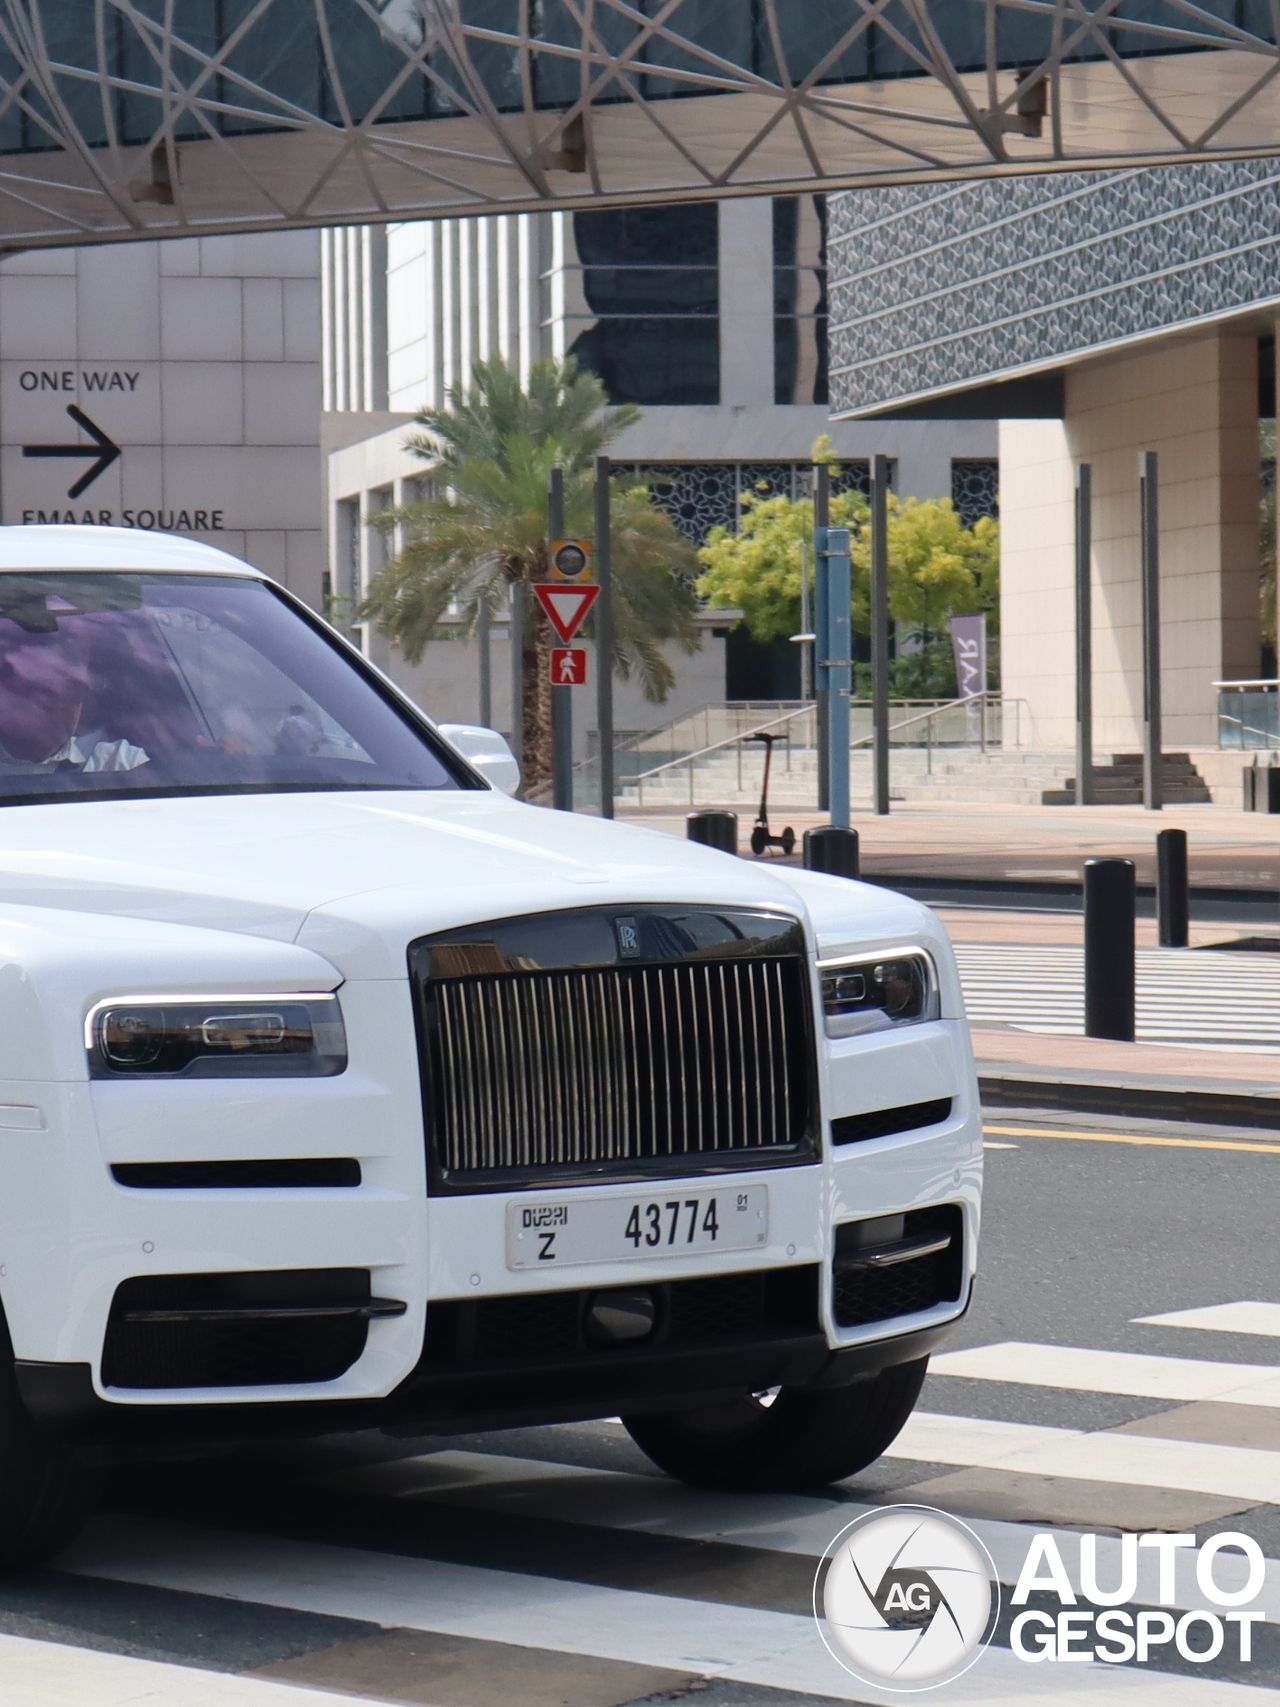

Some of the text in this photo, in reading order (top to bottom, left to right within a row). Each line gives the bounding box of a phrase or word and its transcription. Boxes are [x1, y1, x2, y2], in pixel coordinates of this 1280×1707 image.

[20, 371, 139, 391] ONE WAY
[123, 509, 224, 530] SQUARE
[523, 1206, 568, 1228] DUBAI
[625, 1198, 719, 1248] 43774
[538, 1232, 556, 1260] Z
